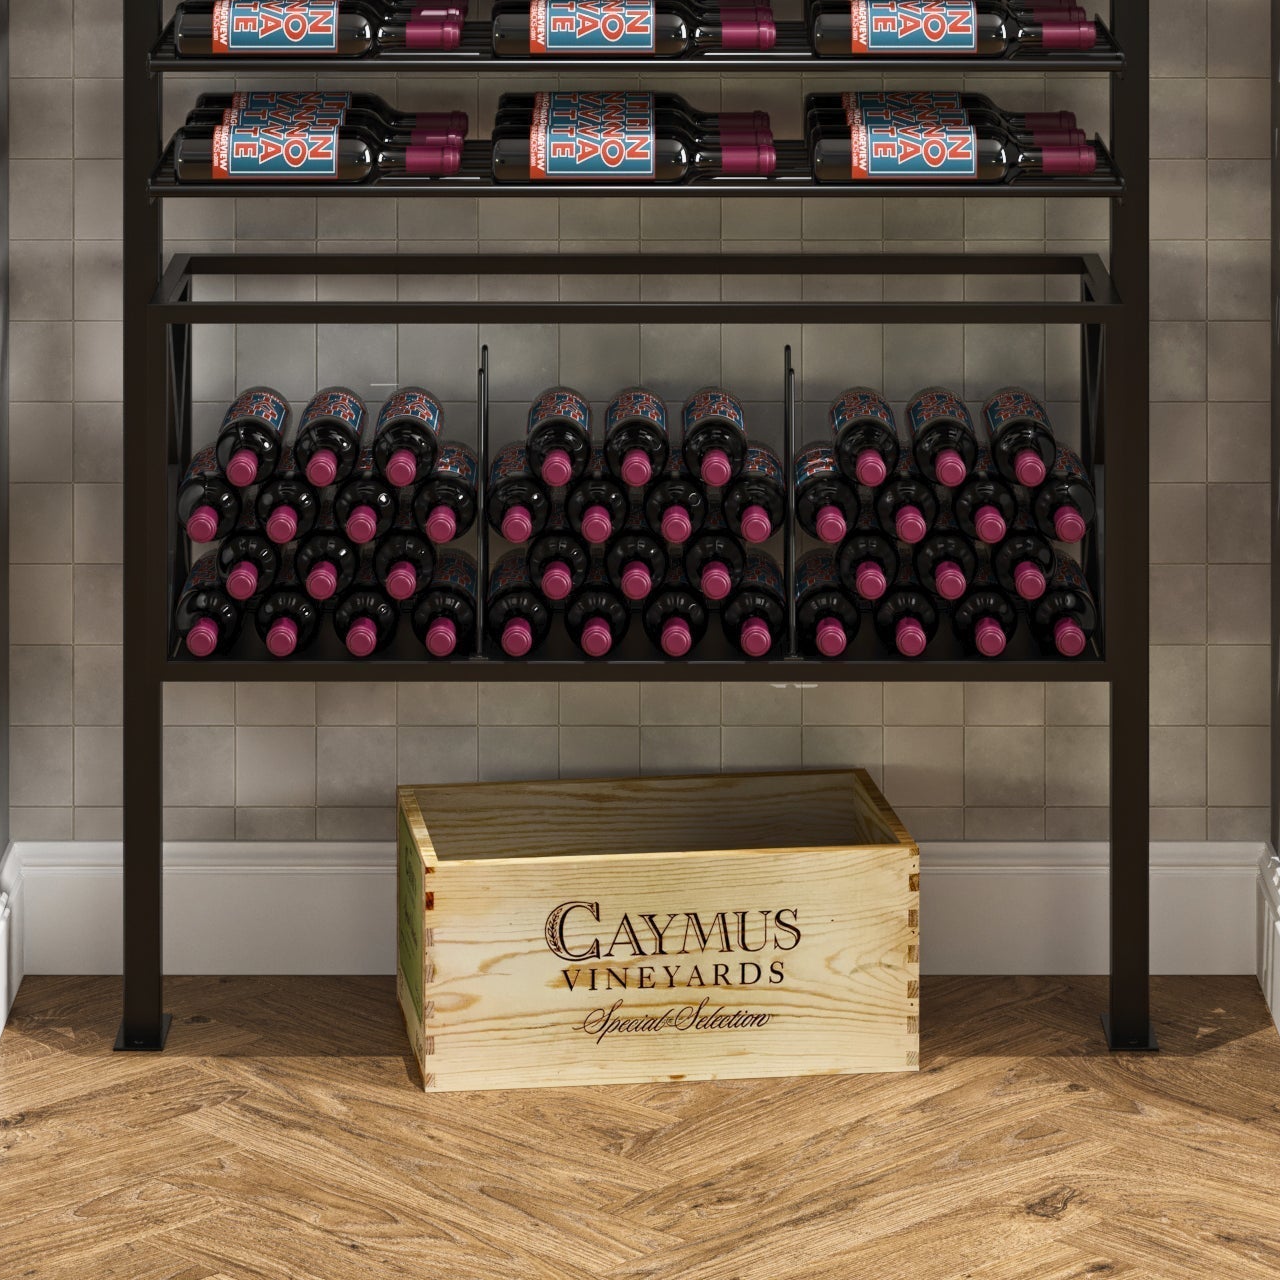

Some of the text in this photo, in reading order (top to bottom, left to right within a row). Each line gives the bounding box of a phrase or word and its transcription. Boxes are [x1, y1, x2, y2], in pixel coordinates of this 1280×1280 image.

[544, 900, 802, 962] CAYMUS
[561, 961, 786, 992] VINEYARDS
[572, 996, 771, 1045] Special Selection
